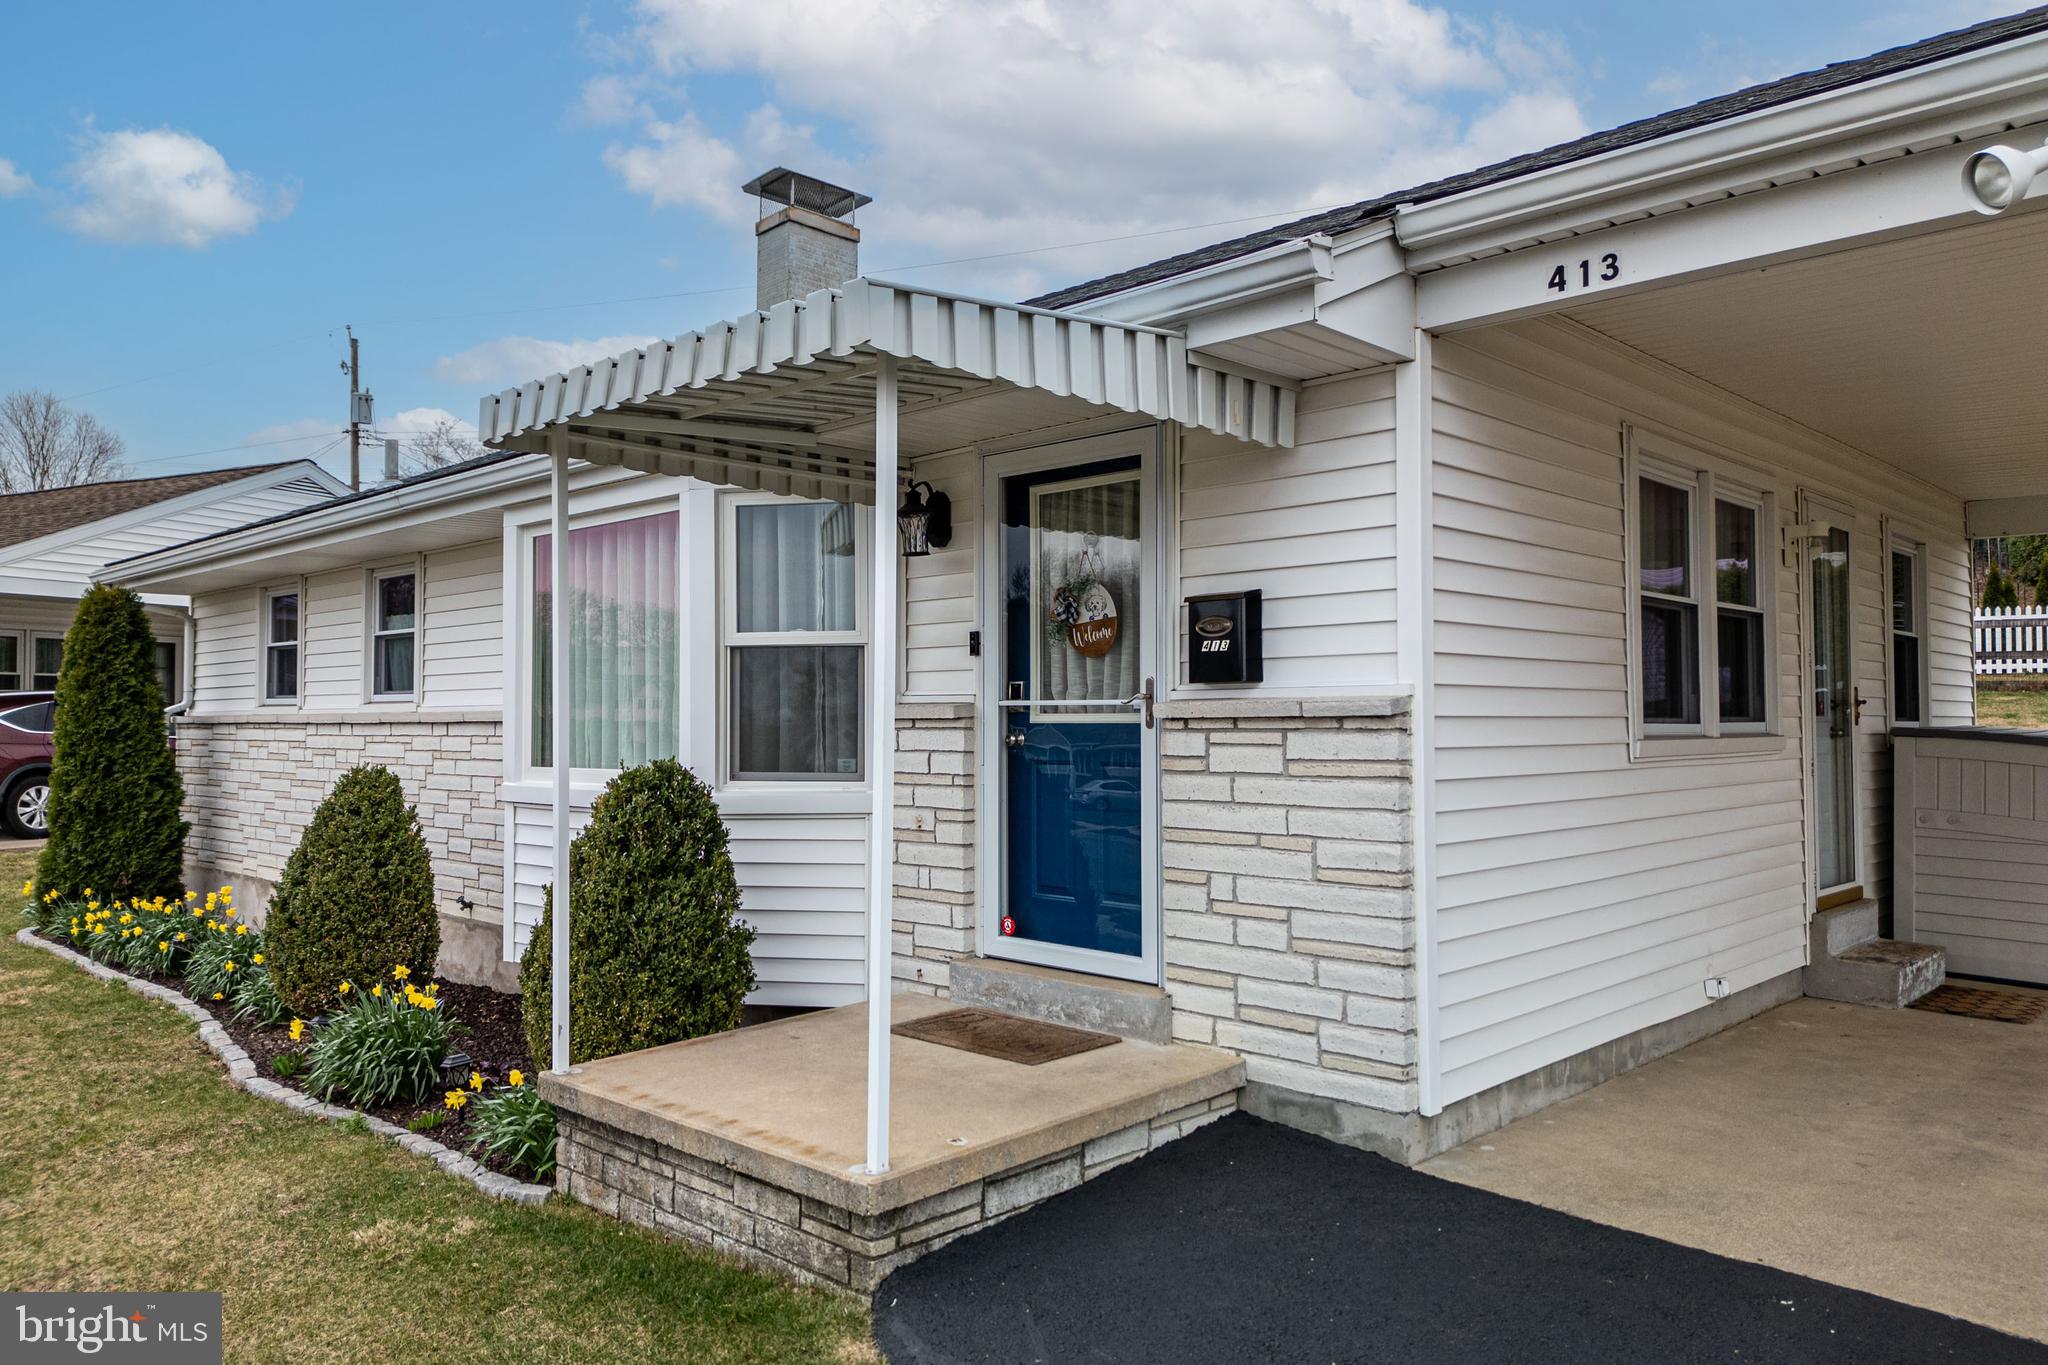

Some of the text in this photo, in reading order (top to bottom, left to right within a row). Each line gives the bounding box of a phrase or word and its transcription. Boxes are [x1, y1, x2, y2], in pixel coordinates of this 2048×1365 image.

[1548, 253, 1620, 292] 413
[1072, 625, 1113, 648] Welcome
[1202, 640, 1229, 651] 413
